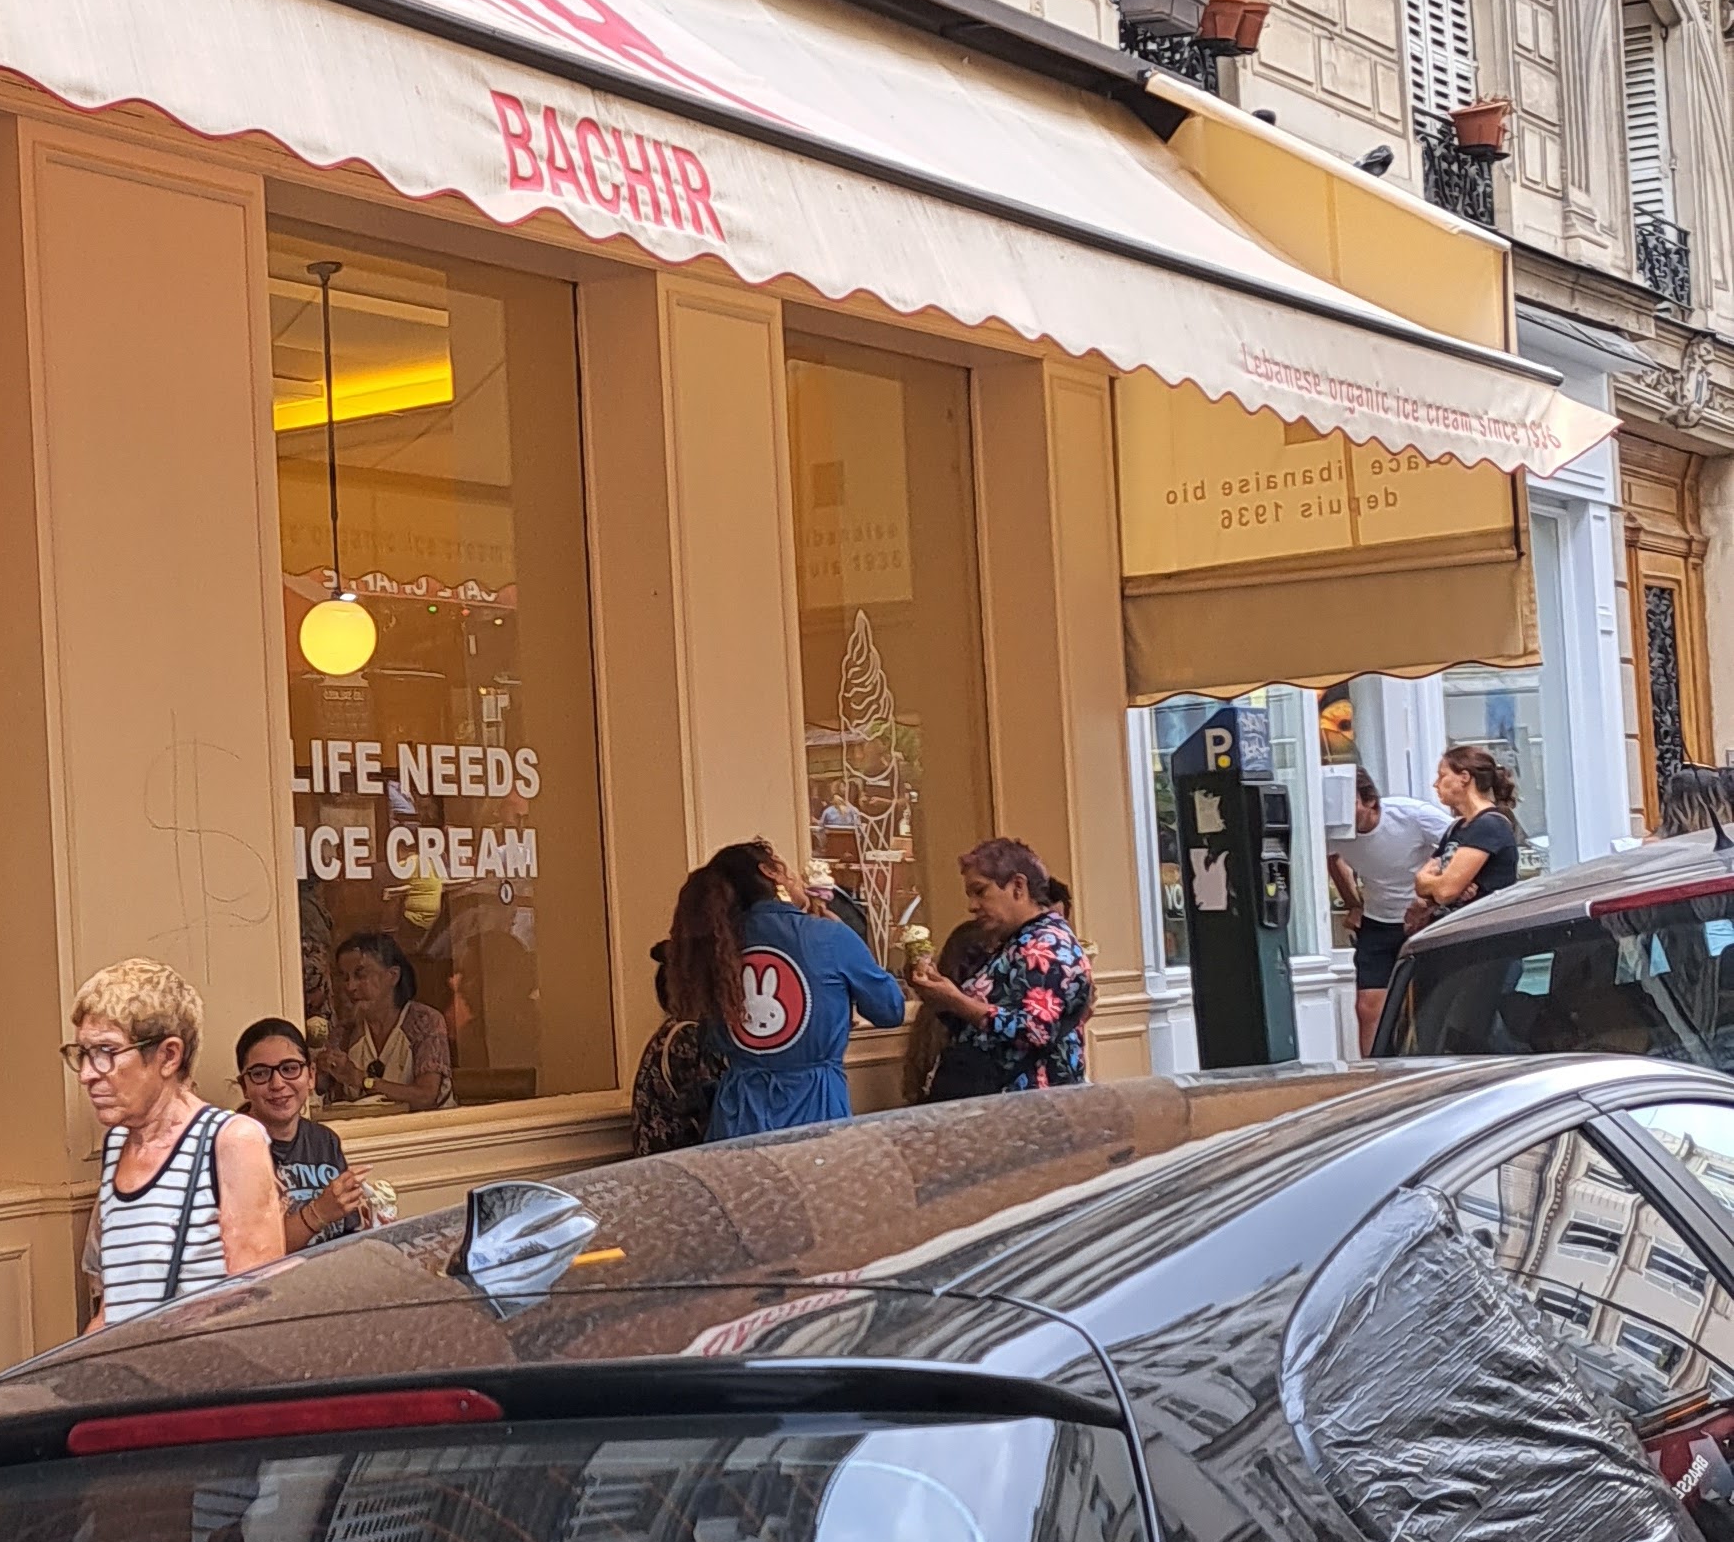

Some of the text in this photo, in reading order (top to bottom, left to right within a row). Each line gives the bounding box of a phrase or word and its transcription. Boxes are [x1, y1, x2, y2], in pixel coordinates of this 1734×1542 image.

[491, 89, 726, 242] BACHIR
[1240, 342, 1322, 395] Lebanese
[1329, 380, 1390, 415] organic
[1396, 387, 1419, 423] ice
[1426, 403, 1473, 436] cream
[1478, 410, 1520, 443] since
[291, 739, 541, 799] LIFE NEEDS
[294, 826, 538, 881] ICE CREAM
